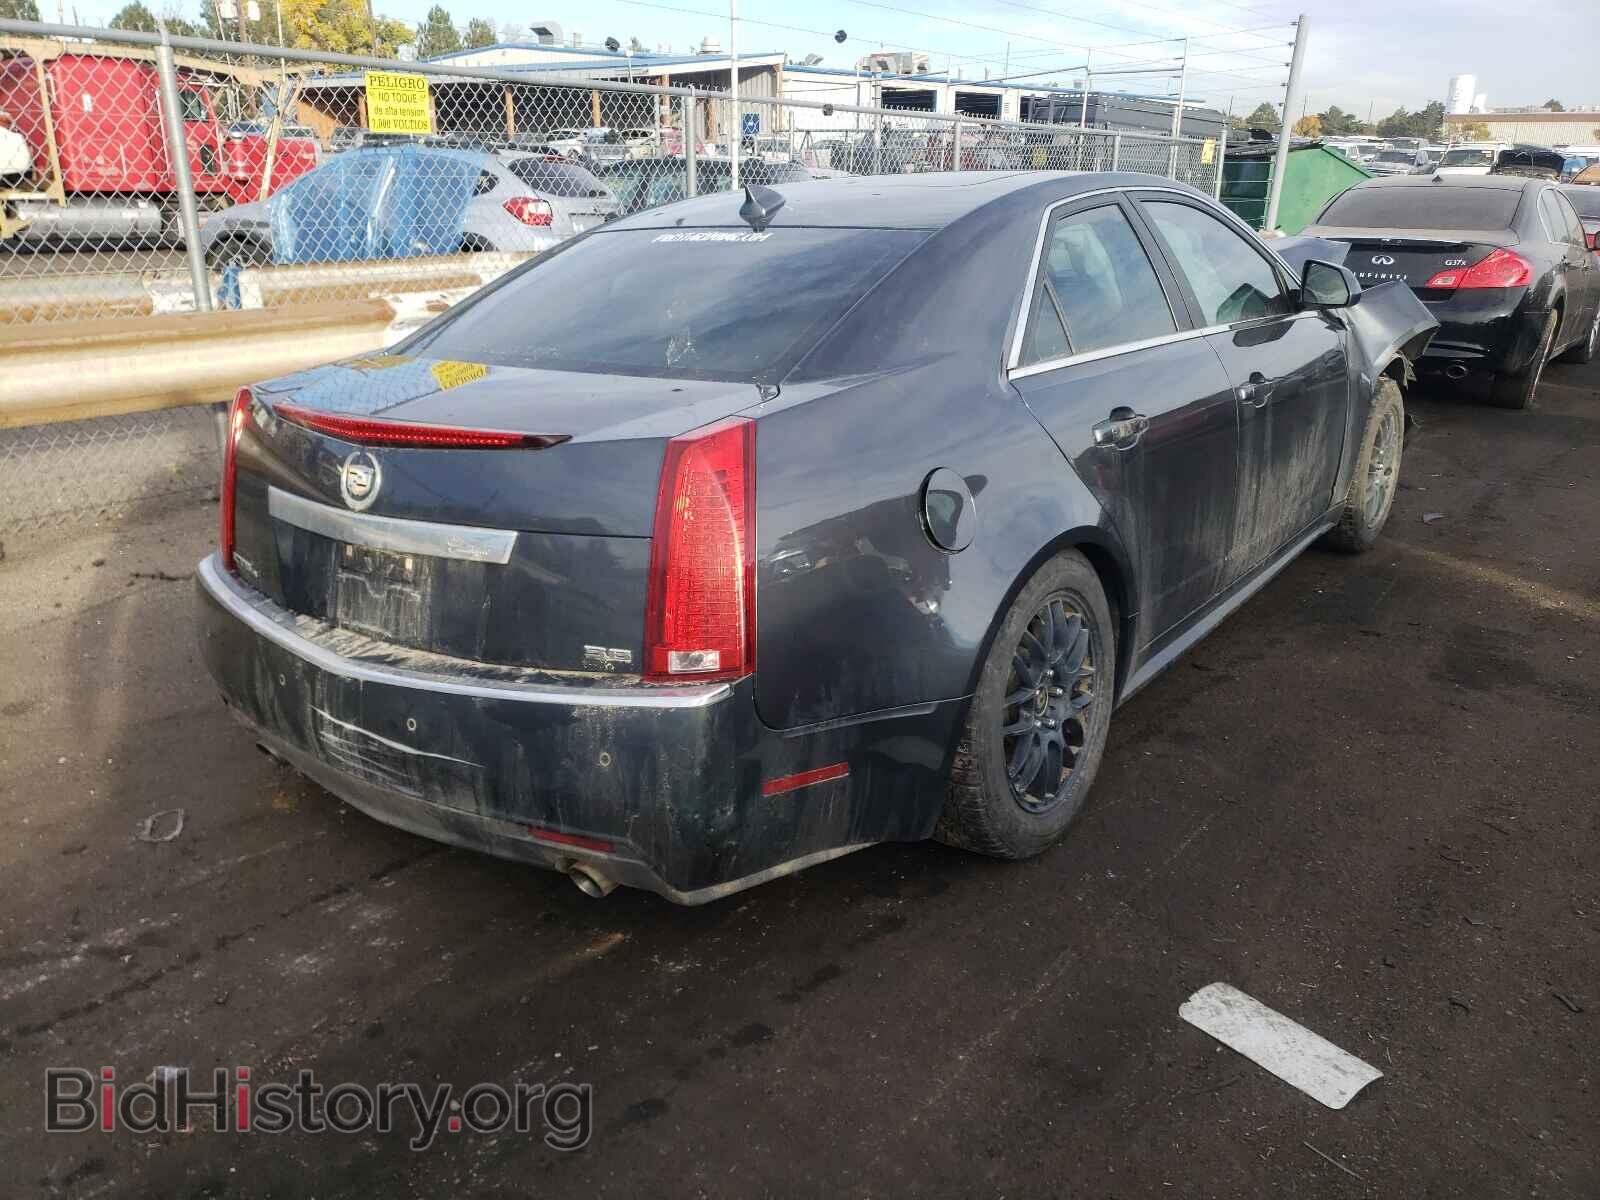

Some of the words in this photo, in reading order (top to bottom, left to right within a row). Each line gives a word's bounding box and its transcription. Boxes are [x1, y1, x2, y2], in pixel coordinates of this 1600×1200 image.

[369, 75, 425, 90] PELIGRO
[378, 91, 390, 101] NO
[392, 92, 418, 104] TOQUE
[374, 104, 383, 115] de
[392, 119, 429, 130] VOLTIOS
[1353, 271, 1408, 280] INFINITI
